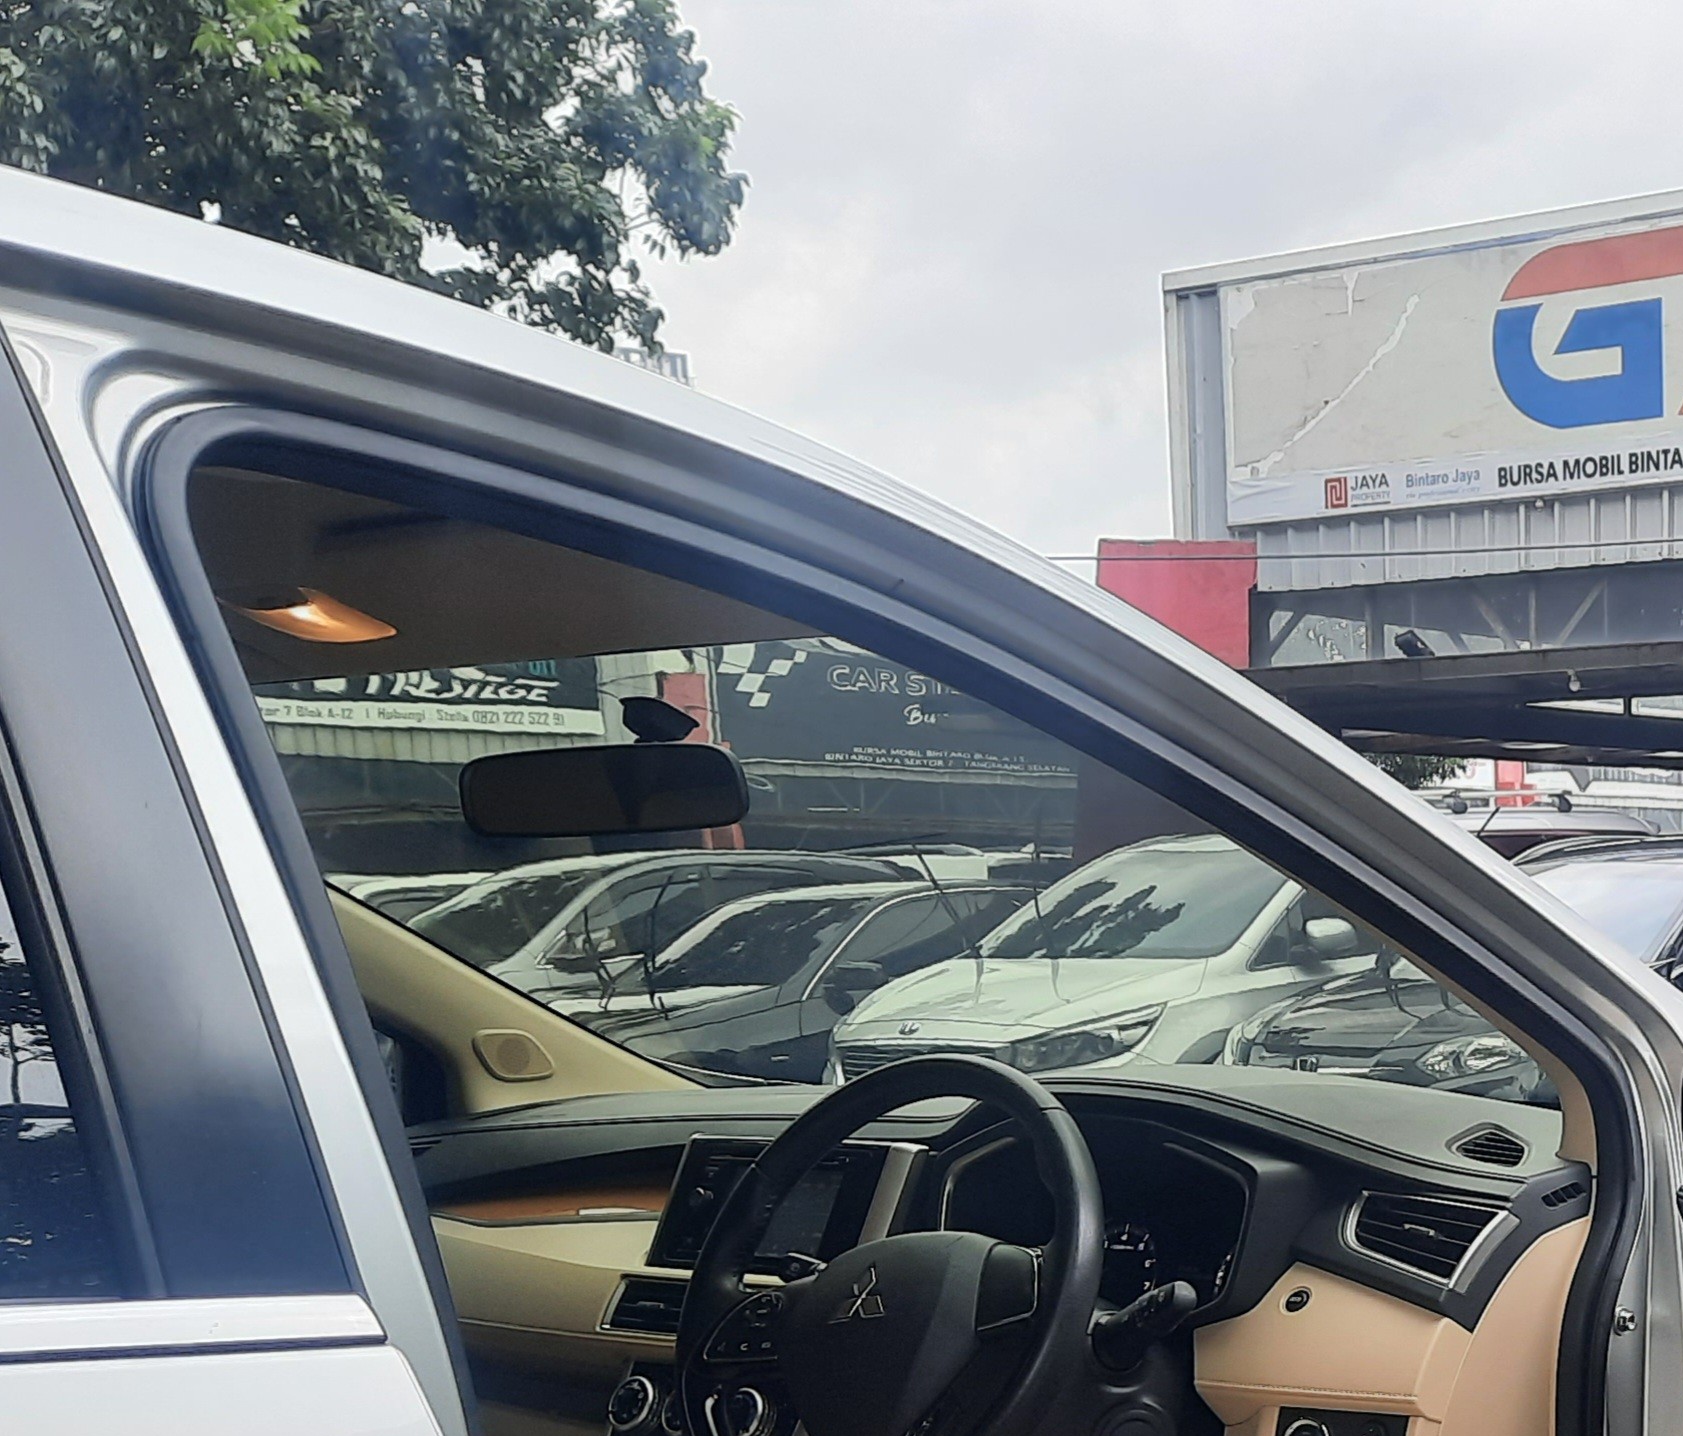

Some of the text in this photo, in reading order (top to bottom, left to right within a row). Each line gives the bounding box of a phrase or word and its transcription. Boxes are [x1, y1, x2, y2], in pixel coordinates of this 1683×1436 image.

[1405, 468, 1480, 488] Bintaro Jaya
[1498, 460, 1559, 489] BURSA
[1562, 453, 1625, 482] MOBIL
[1350, 472, 1390, 491] JAYA
[1350, 490, 1391, 501] PROPERTY
[826, 664, 900, 694] CAR
